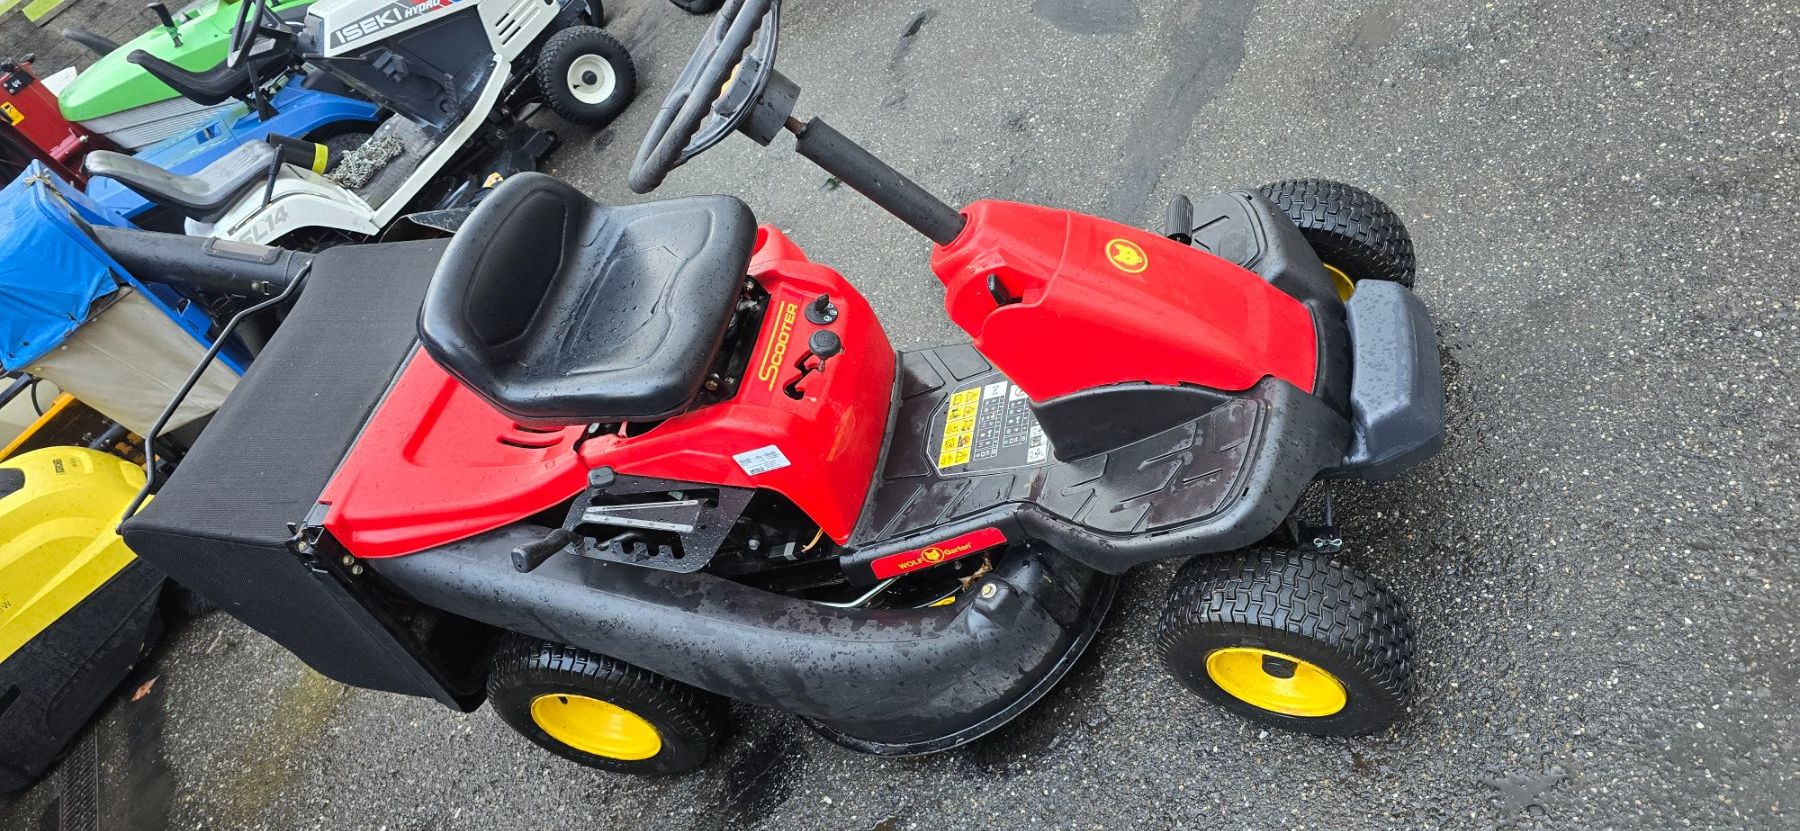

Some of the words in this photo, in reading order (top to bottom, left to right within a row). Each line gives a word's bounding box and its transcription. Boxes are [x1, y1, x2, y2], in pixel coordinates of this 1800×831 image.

[335, 8, 402, 44] ISEKI
[758, 301, 798, 391] SCOOTER
[897, 557, 923, 570] WOLF
[943, 543, 972, 556] Garten
